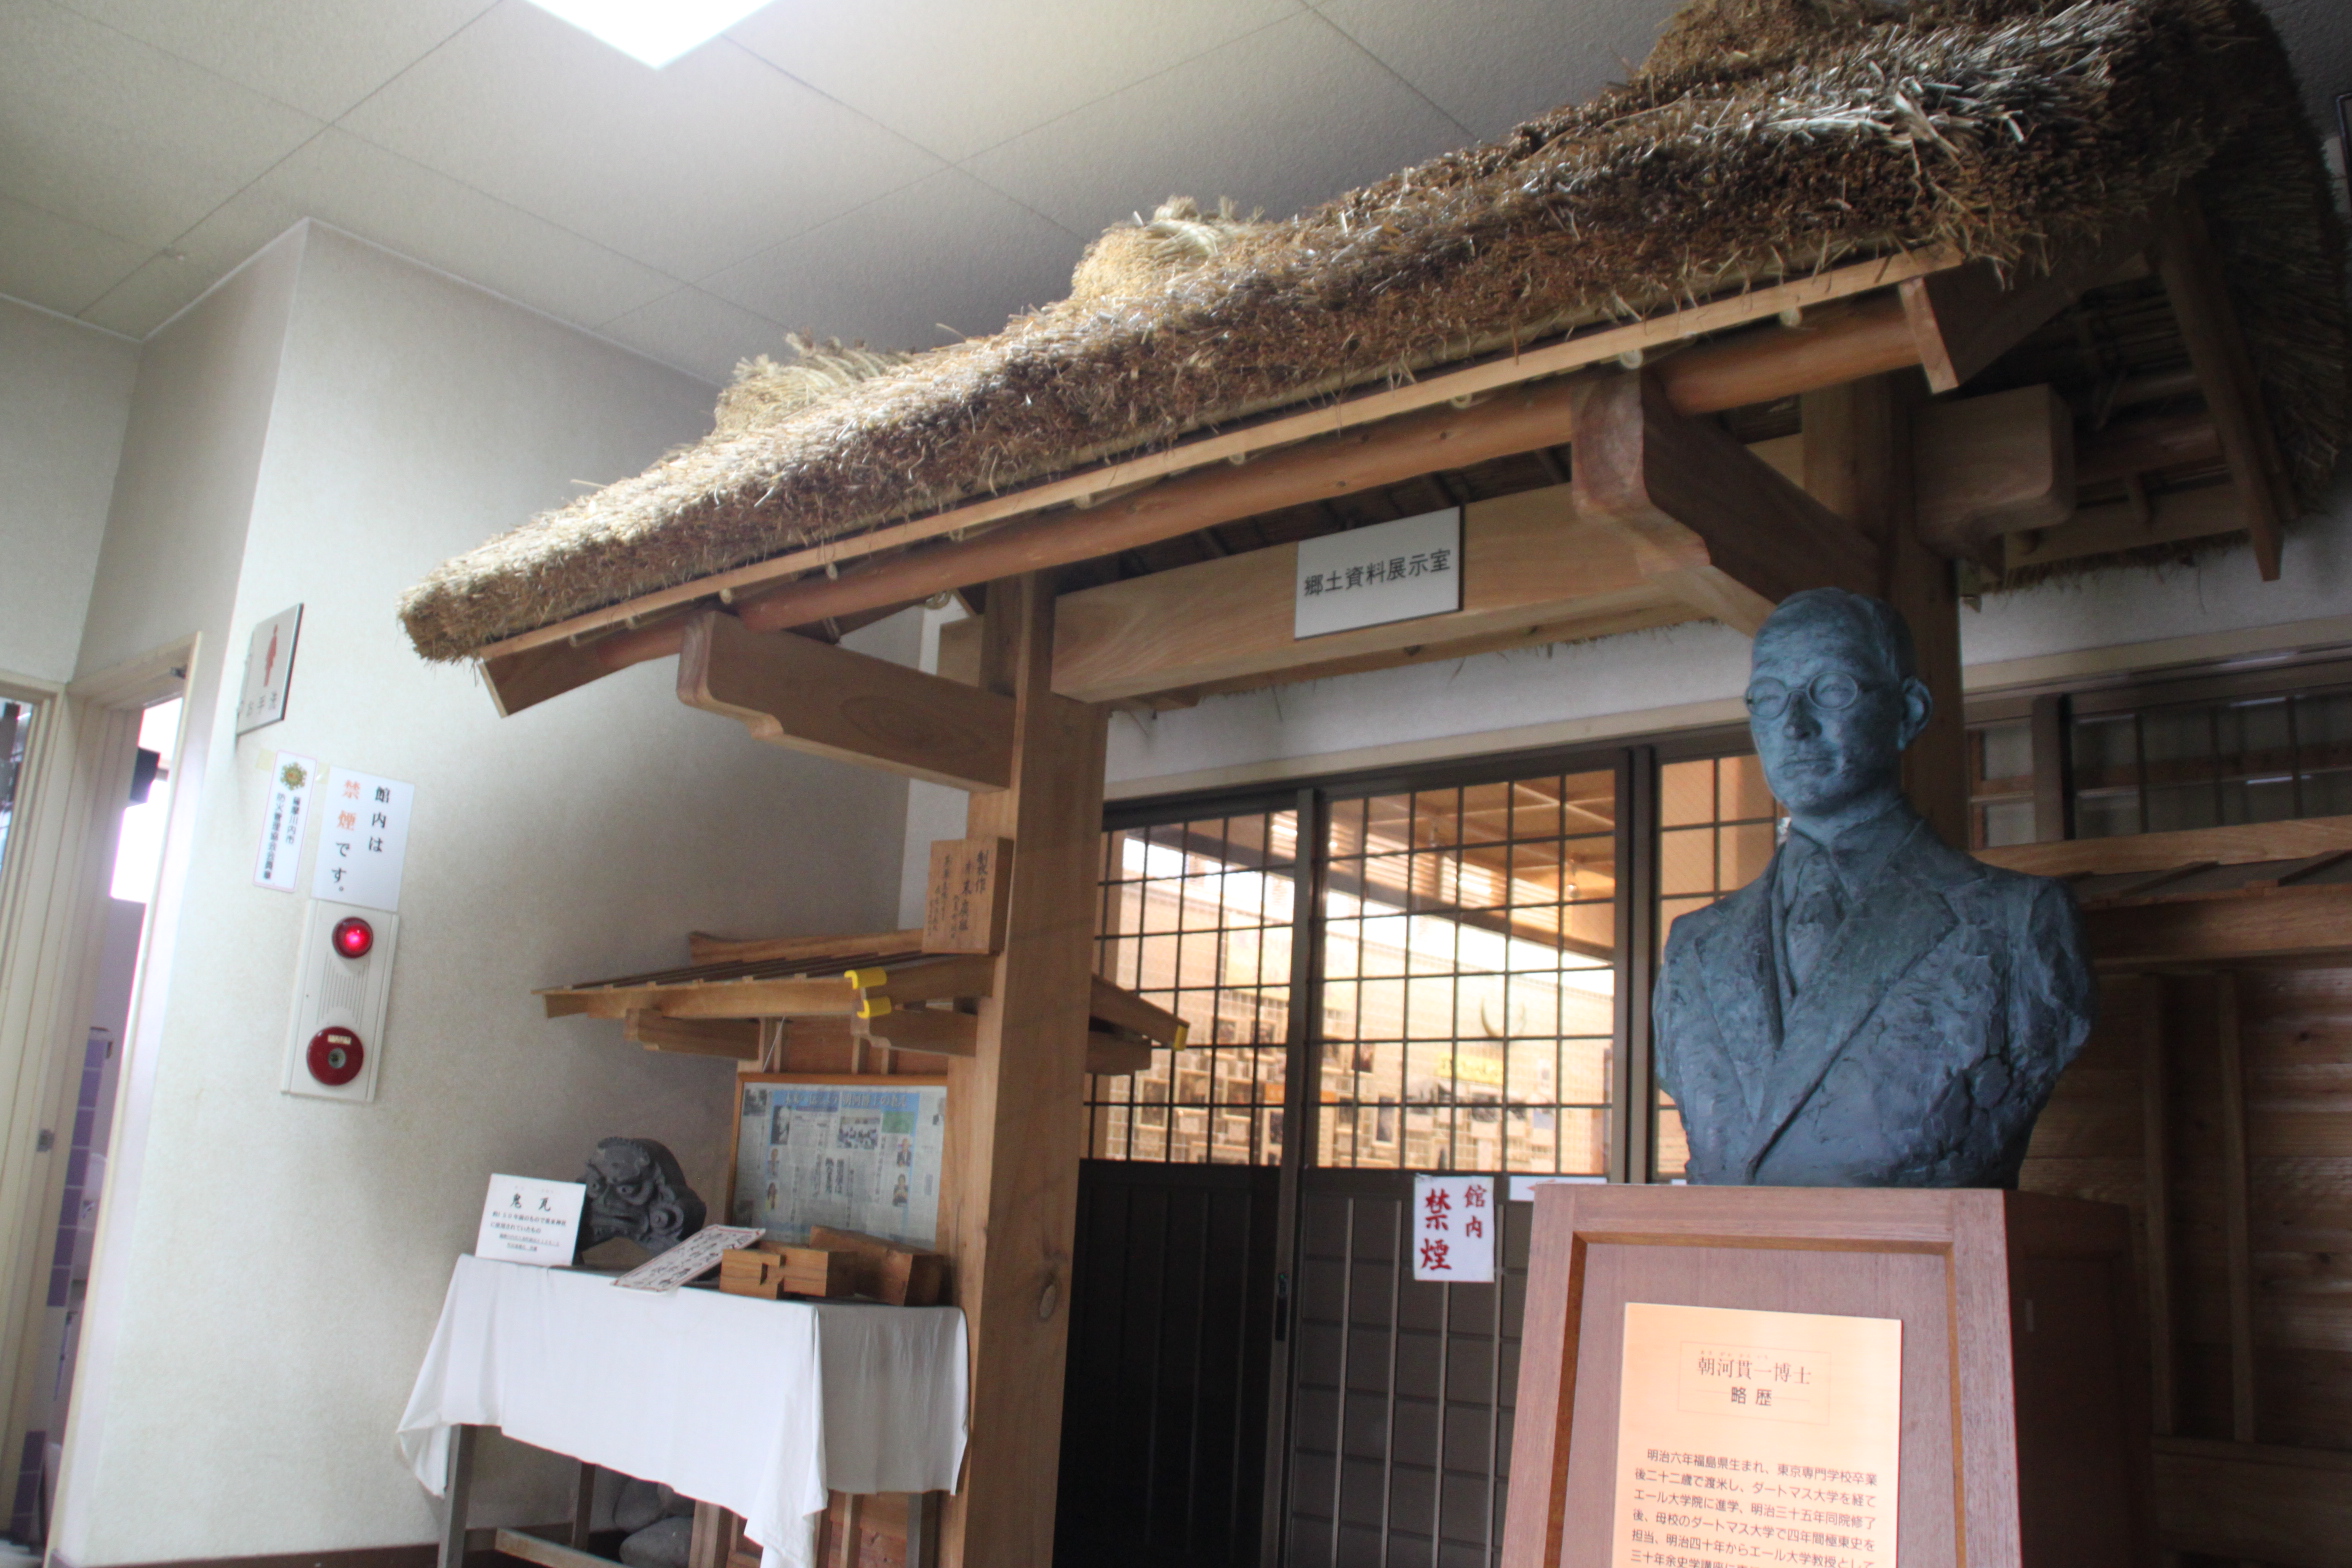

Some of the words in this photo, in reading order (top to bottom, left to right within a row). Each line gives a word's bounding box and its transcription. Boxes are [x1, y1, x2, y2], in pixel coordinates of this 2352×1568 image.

[1304, 548, 1451, 597] 郷土資料展示室
[331, 779, 362, 892] 禁煙です。
[368, 786, 391, 853] 館内は
[1420, 1187, 1452, 1272] 禁煙
[1464, 1184, 1487, 1239] 館内
[1697, 1356, 1812, 1385] 朝河貫一博士
[1730, 1386, 1773, 1407] 略歴
[1635, 1467, 1878, 1508] 後二十二歳で渡米し、ダートマス大学を経て
[1647, 1448, 1878, 1486] 明治六年福島県生まれ、東京専門学校卒業
[1632, 1508, 1876, 1552] 後、母校のダートマス大学で四年間極東史を
[1634, 1488, 1877, 1530] エール大学院に進学、明治三十五年同院修了
